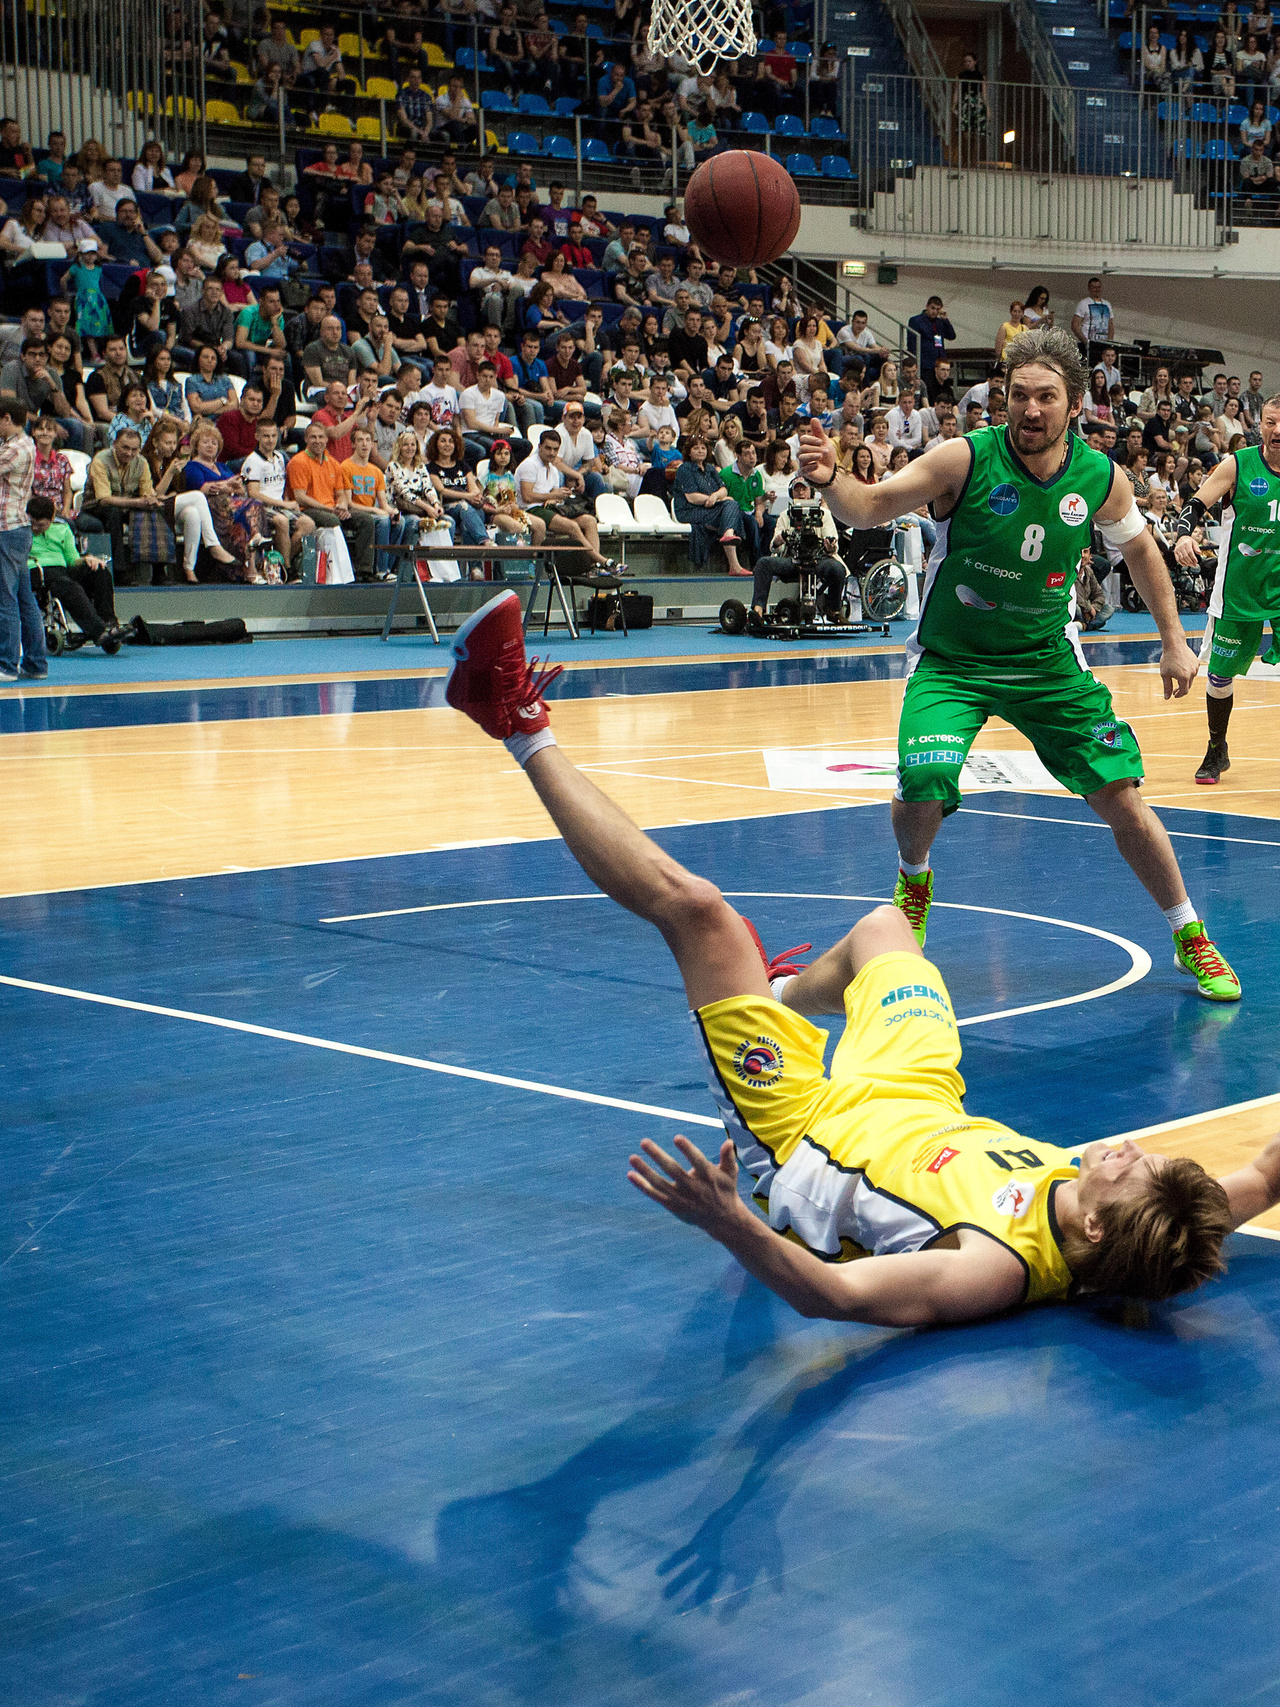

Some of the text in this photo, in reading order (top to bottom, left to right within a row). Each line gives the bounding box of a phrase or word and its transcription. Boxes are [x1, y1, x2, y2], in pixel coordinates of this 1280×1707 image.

[352, 475, 376, 495] 52
[1247, 525, 1275, 534] астерос
[1020, 523, 1046, 562] 8
[974, 560, 1023, 581] астерос
[1217, 635, 1242, 644] астерос
[918, 734, 965, 746] астерос
[905, 750, 964, 767] СИБУР
[881, 984, 949, 1013] СИБУР
[885, 1008, 945, 1027] астерос
